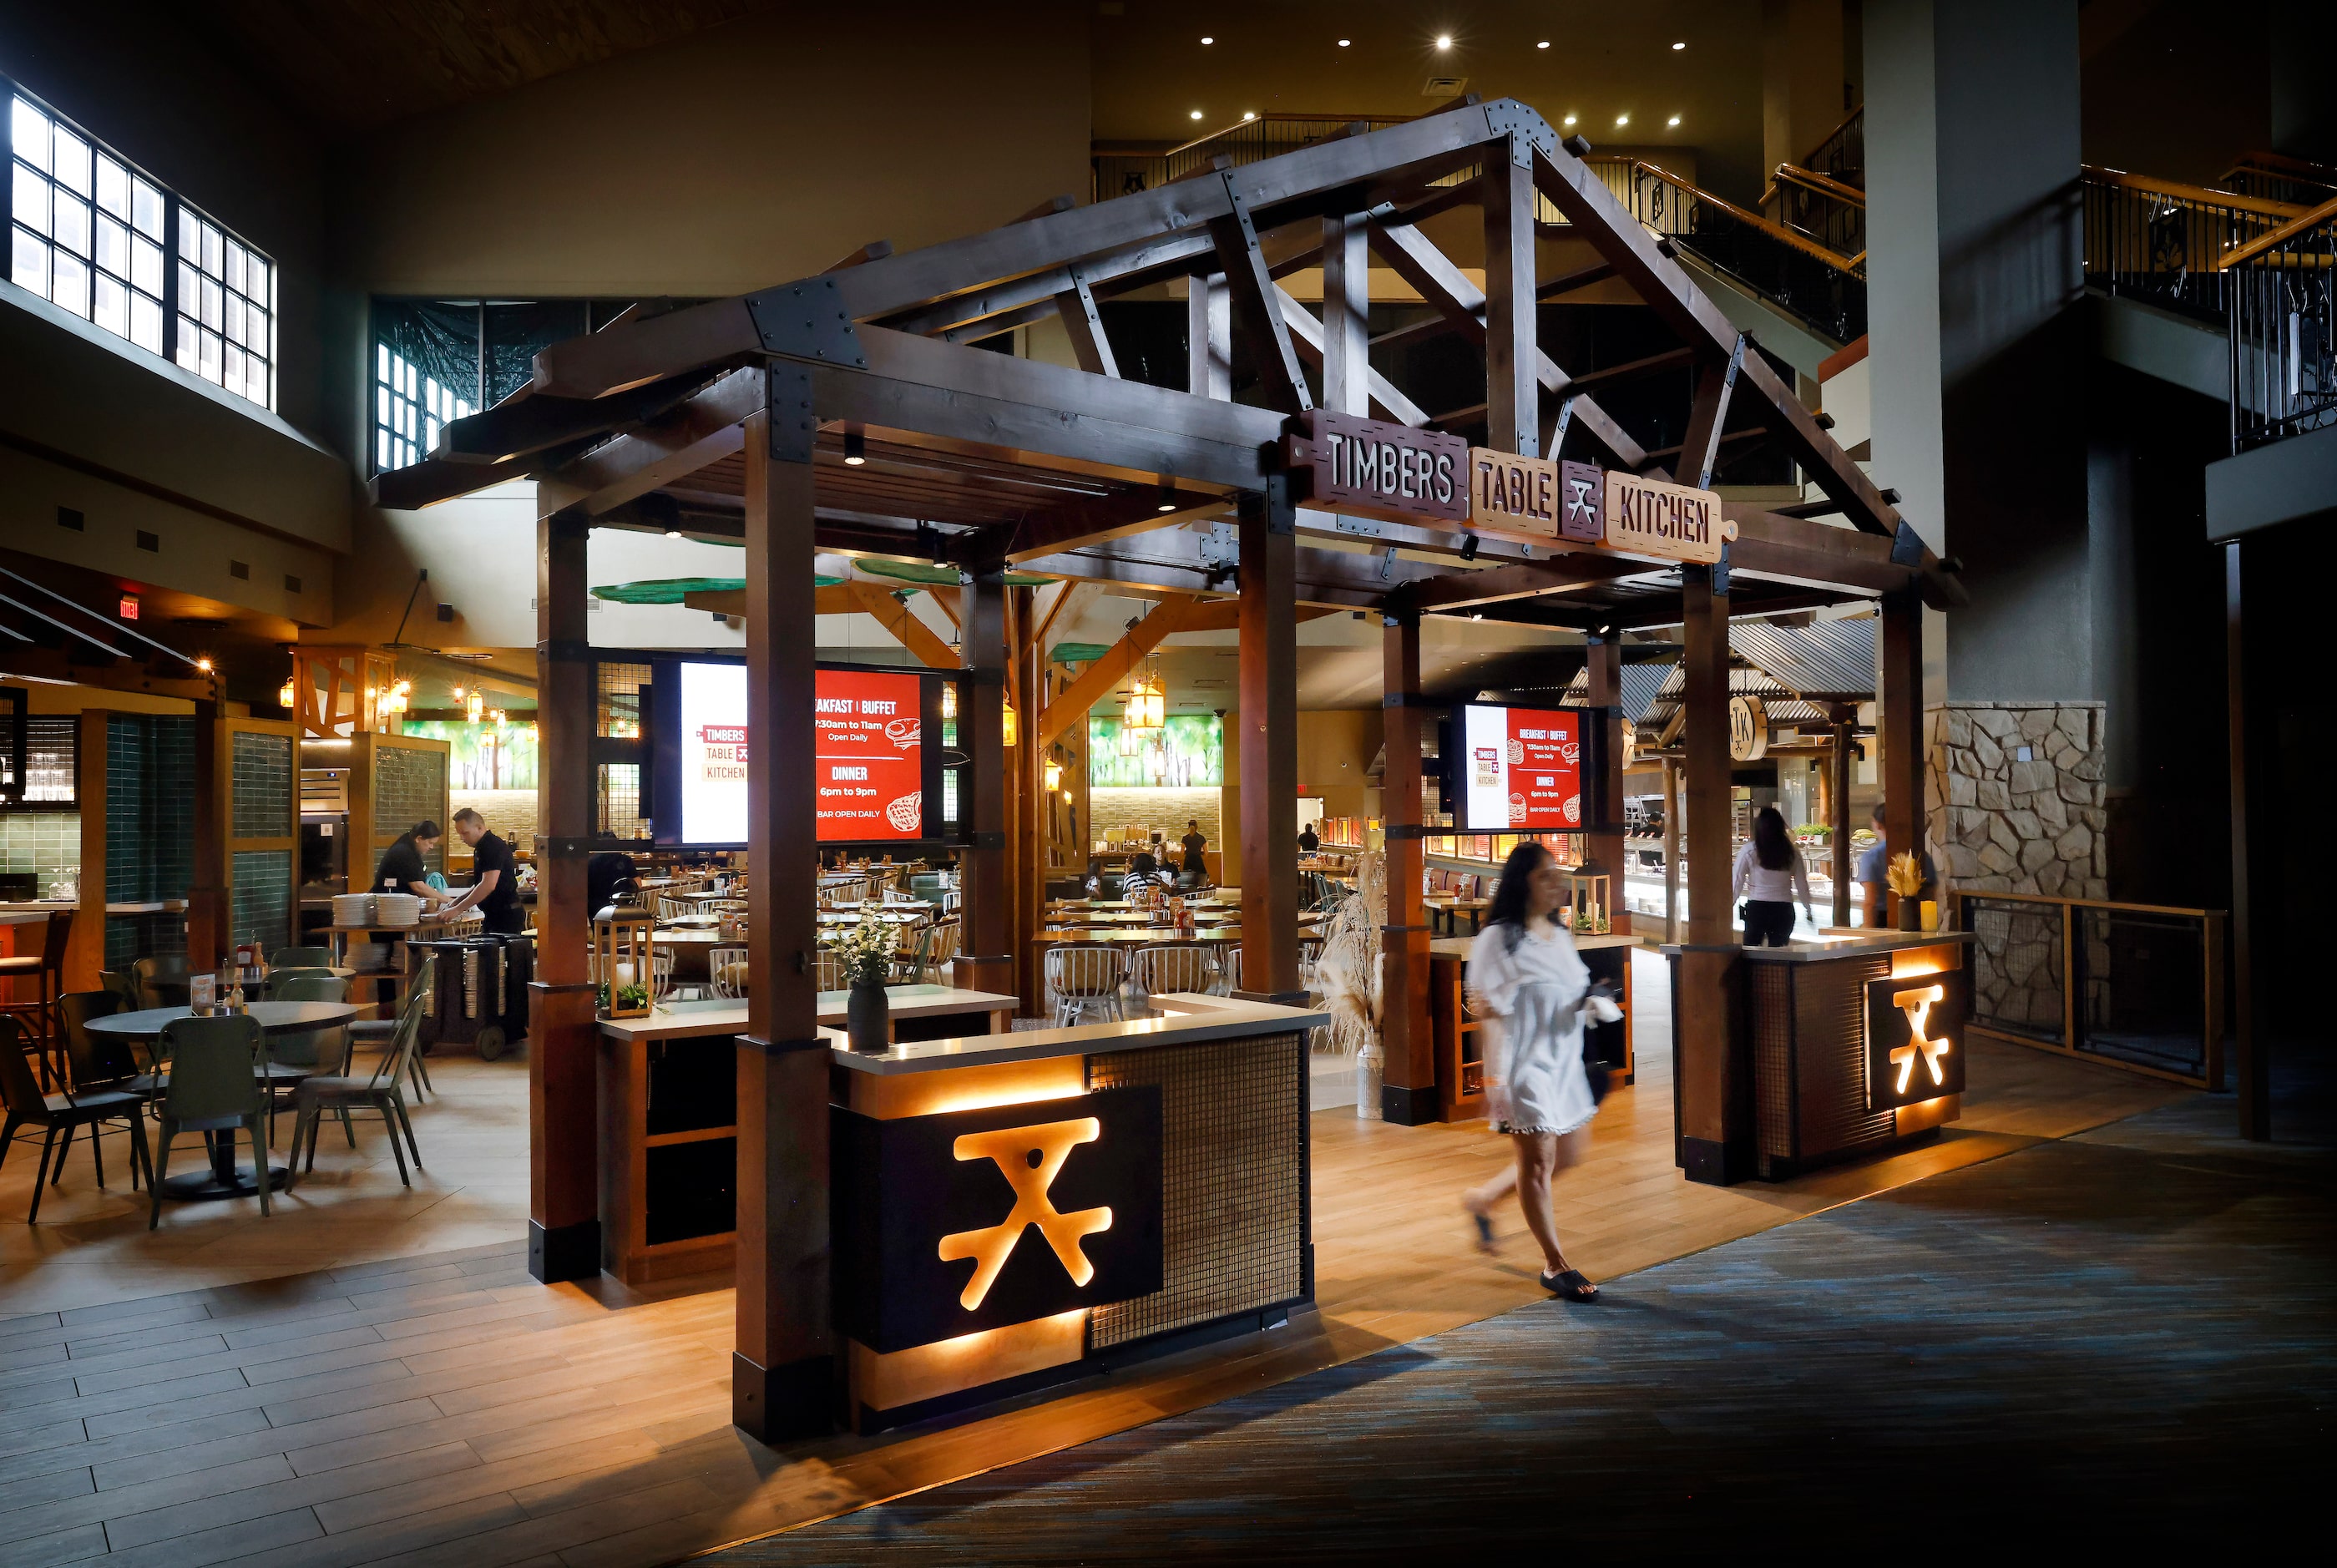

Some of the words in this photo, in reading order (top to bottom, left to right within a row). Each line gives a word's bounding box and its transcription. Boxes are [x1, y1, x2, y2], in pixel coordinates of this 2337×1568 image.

[1327, 432, 1455, 504] TIMBERS
[1477, 461, 1552, 521] TABLE
[1621, 485, 1709, 544] KITCHEN
[862, 700, 897, 715] BUFFET
[849, 721, 859, 730] to
[861, 721, 883, 731] 11am
[706, 728, 745, 742] TIMBERS
[827, 733, 848, 741] Open
[850, 733, 868, 742] Daily
[1520, 728, 1546, 739] BREAKFAST
[1550, 730, 1567, 741] BUFFET
[707, 747, 733, 759] TABLE
[707, 766, 745, 778] KITCHEN
[1478, 763, 1490, 771] TABLE
[832, 766, 868, 781] DINNER
[1478, 776, 1496, 785] KITCHEN
[1536, 776, 1555, 787] DINNER
[820, 787, 842, 797] 6pm
[843, 787, 854, 796] to
[855, 787, 877, 797] 9pm
